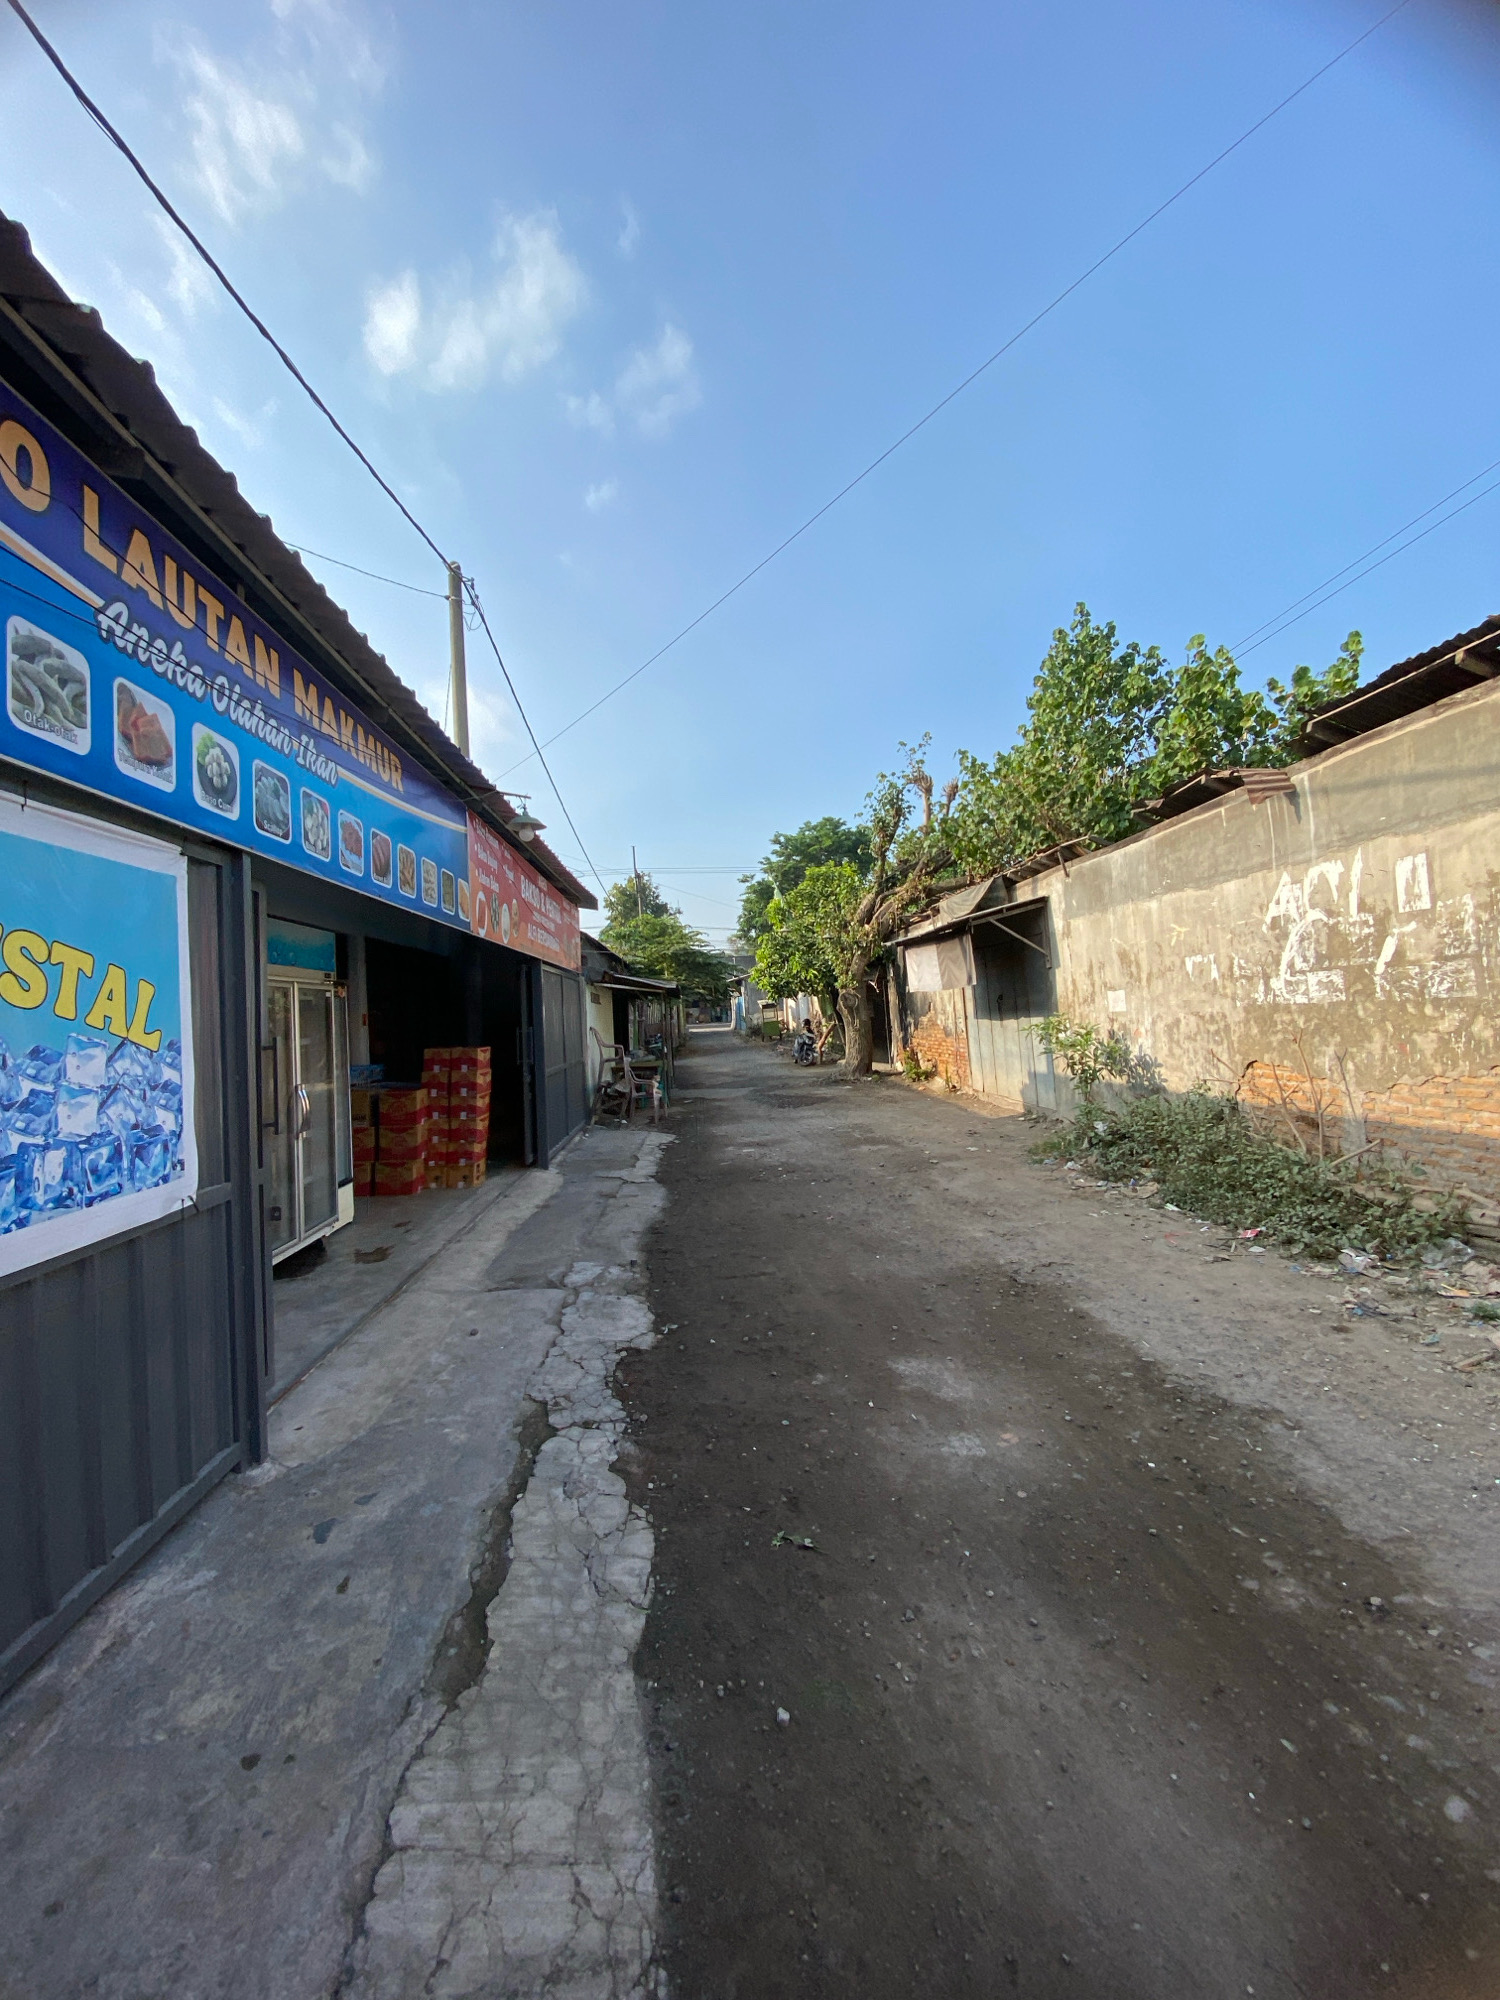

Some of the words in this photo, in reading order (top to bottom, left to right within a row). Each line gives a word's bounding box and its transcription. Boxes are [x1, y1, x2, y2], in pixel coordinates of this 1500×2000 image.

[82, 484, 281, 699] LAUTAN
[292, 667, 404, 793] MAKMUR
[96, 600, 208, 700] Aneka
[211, 673, 293, 757] Olahan
[293, 738, 339, 787] Ikan
[24, 708, 79, 745] Otak-otak
[0, 921, 162, 1053] STAL
